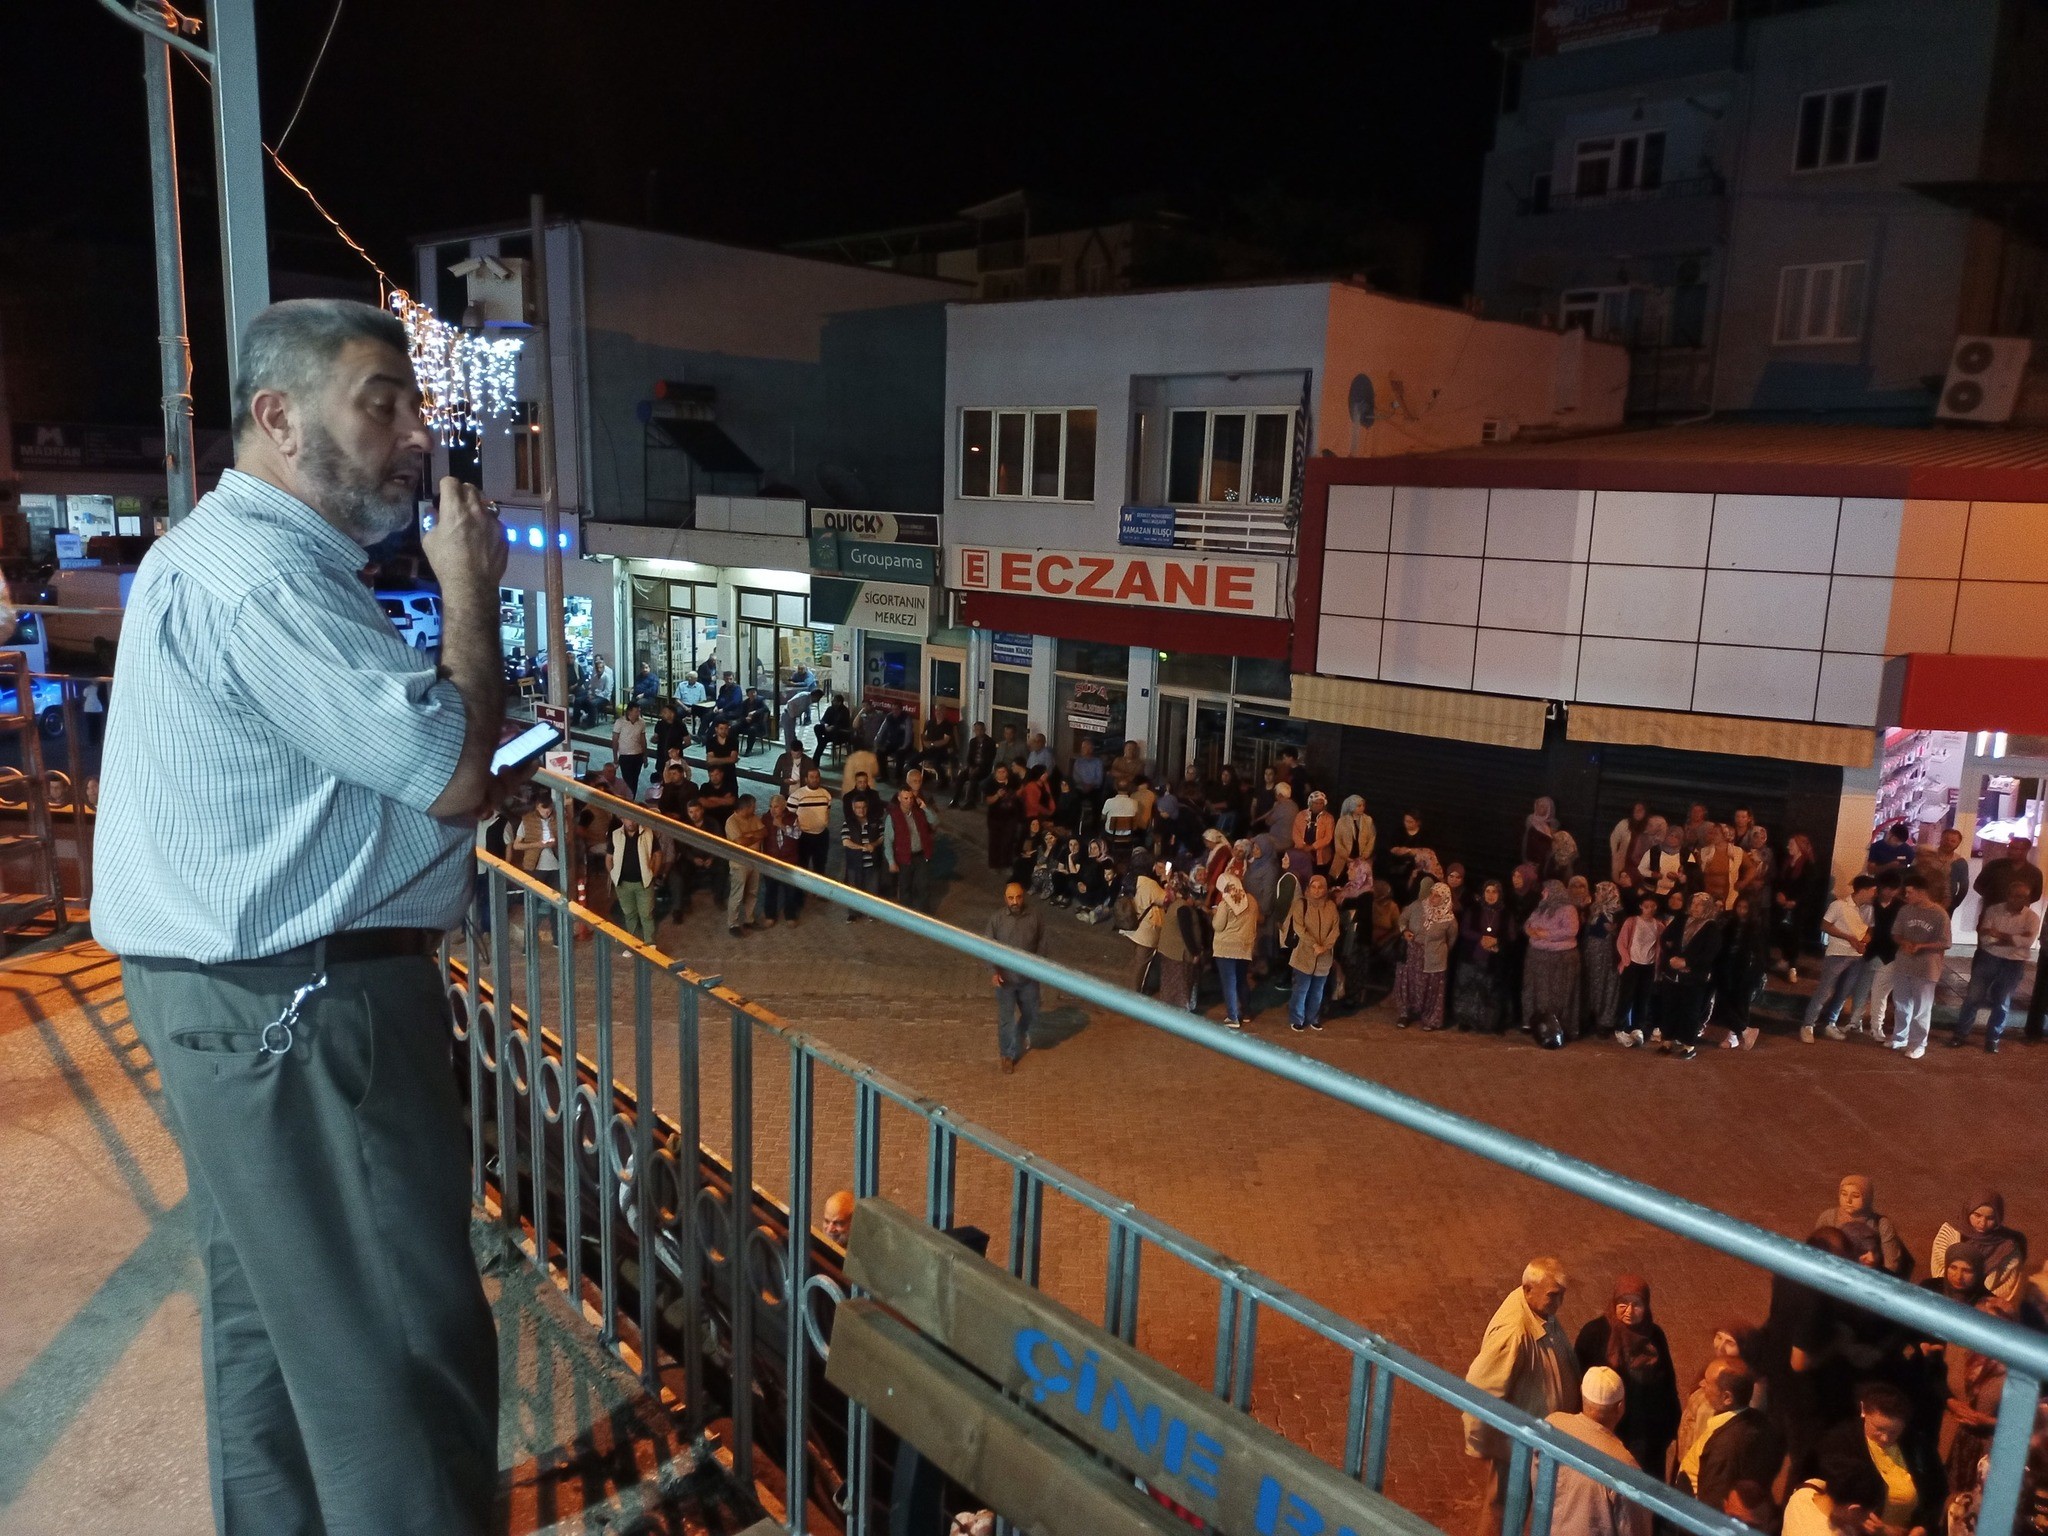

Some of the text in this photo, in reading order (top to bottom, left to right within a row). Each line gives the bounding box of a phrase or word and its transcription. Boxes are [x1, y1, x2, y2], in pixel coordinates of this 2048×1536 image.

[824, 512, 876, 534] QUICK
[1122, 525, 1152, 535] RAMAZAN
[850, 548, 923, 570] Groupama
[1000, 552, 1256, 611] ECZANE
[864, 592, 926, 609] SİGORTANIN
[874, 609, 918, 628] MERKEZİ
[1014, 1326, 1225, 1501] ÇİNE
